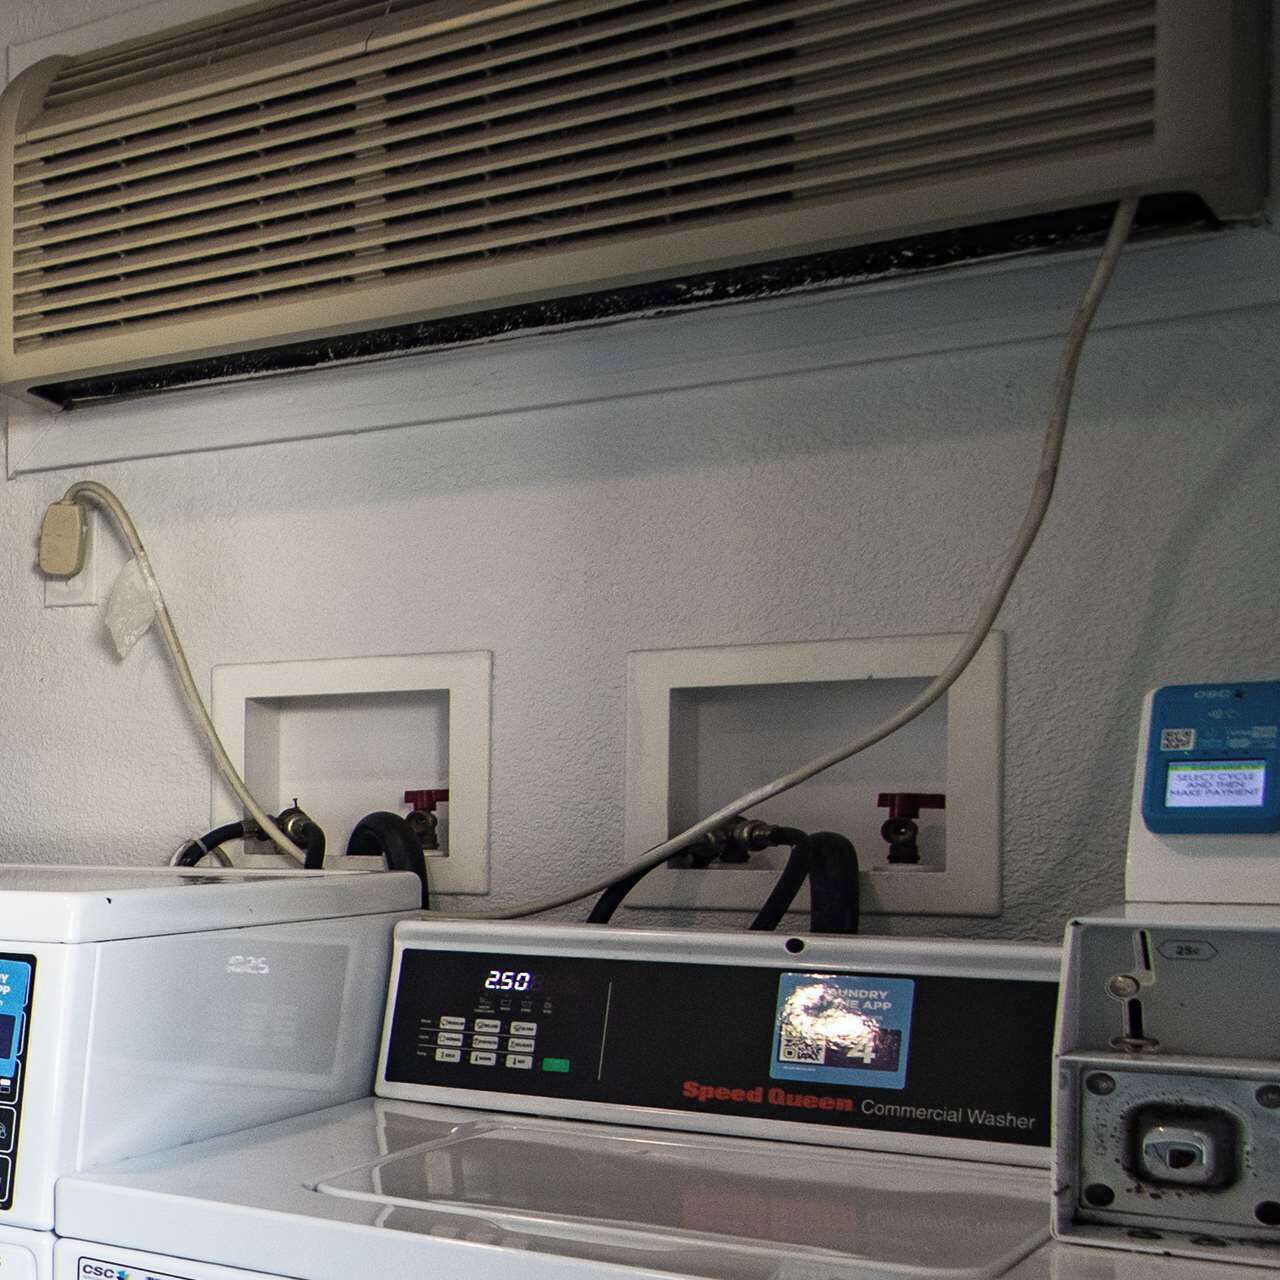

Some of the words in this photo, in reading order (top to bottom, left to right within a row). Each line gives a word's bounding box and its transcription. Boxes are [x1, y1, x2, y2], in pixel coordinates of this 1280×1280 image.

[485, 971, 531, 991] 2.50
[863, 1001, 893, 1011] APP
[682, 1080, 763, 1103] Speed
[768, 1087, 854, 1112] Queen
[860, 1099, 963, 1124] Commercial
[967, 1108, 1036, 1130] Washer
[82, 1264, 115, 1279] CSC
